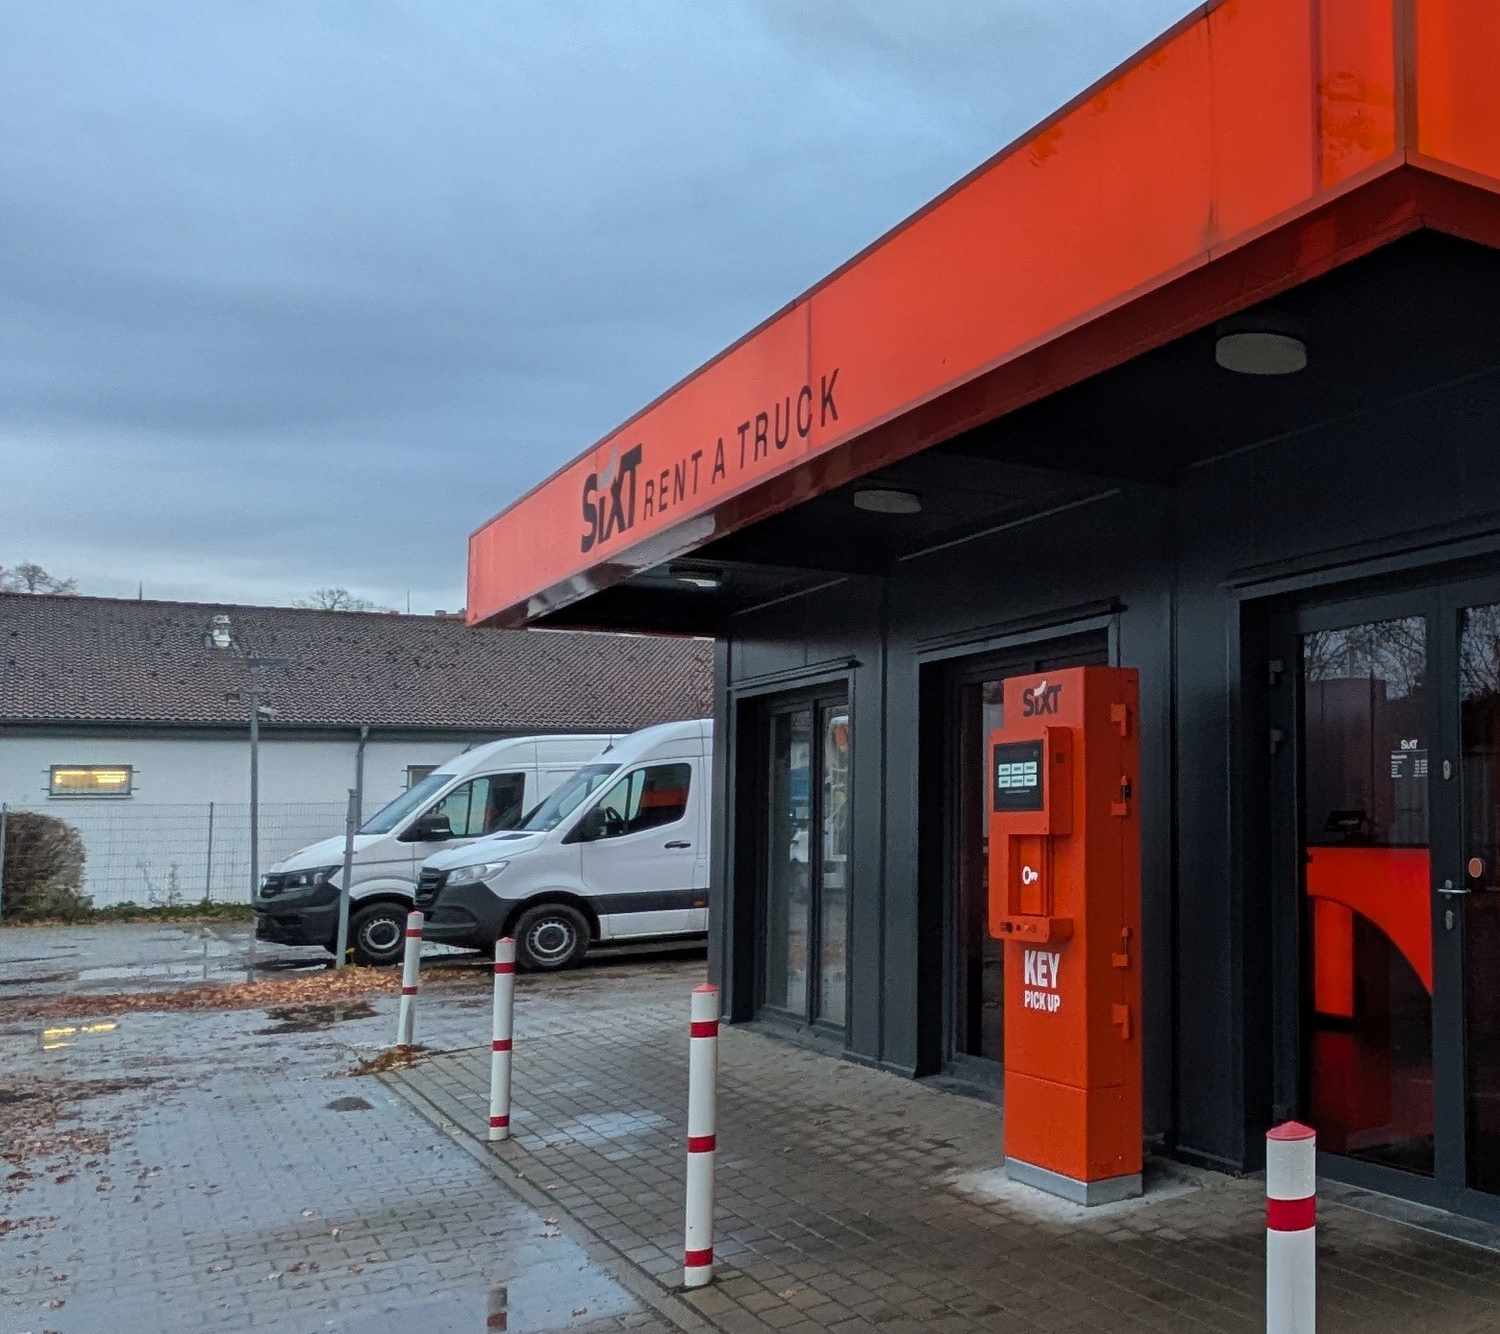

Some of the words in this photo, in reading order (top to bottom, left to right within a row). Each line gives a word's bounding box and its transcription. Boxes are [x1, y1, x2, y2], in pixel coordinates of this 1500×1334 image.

[643, 449, 702, 521] RENT
[711, 437, 725, 484] A
[737, 368, 839, 469] TRUCK
[1024, 950, 1060, 988] KEY
[1024, 990, 1046, 1010] PICK
[1047, 993, 1060, 1012] UP
